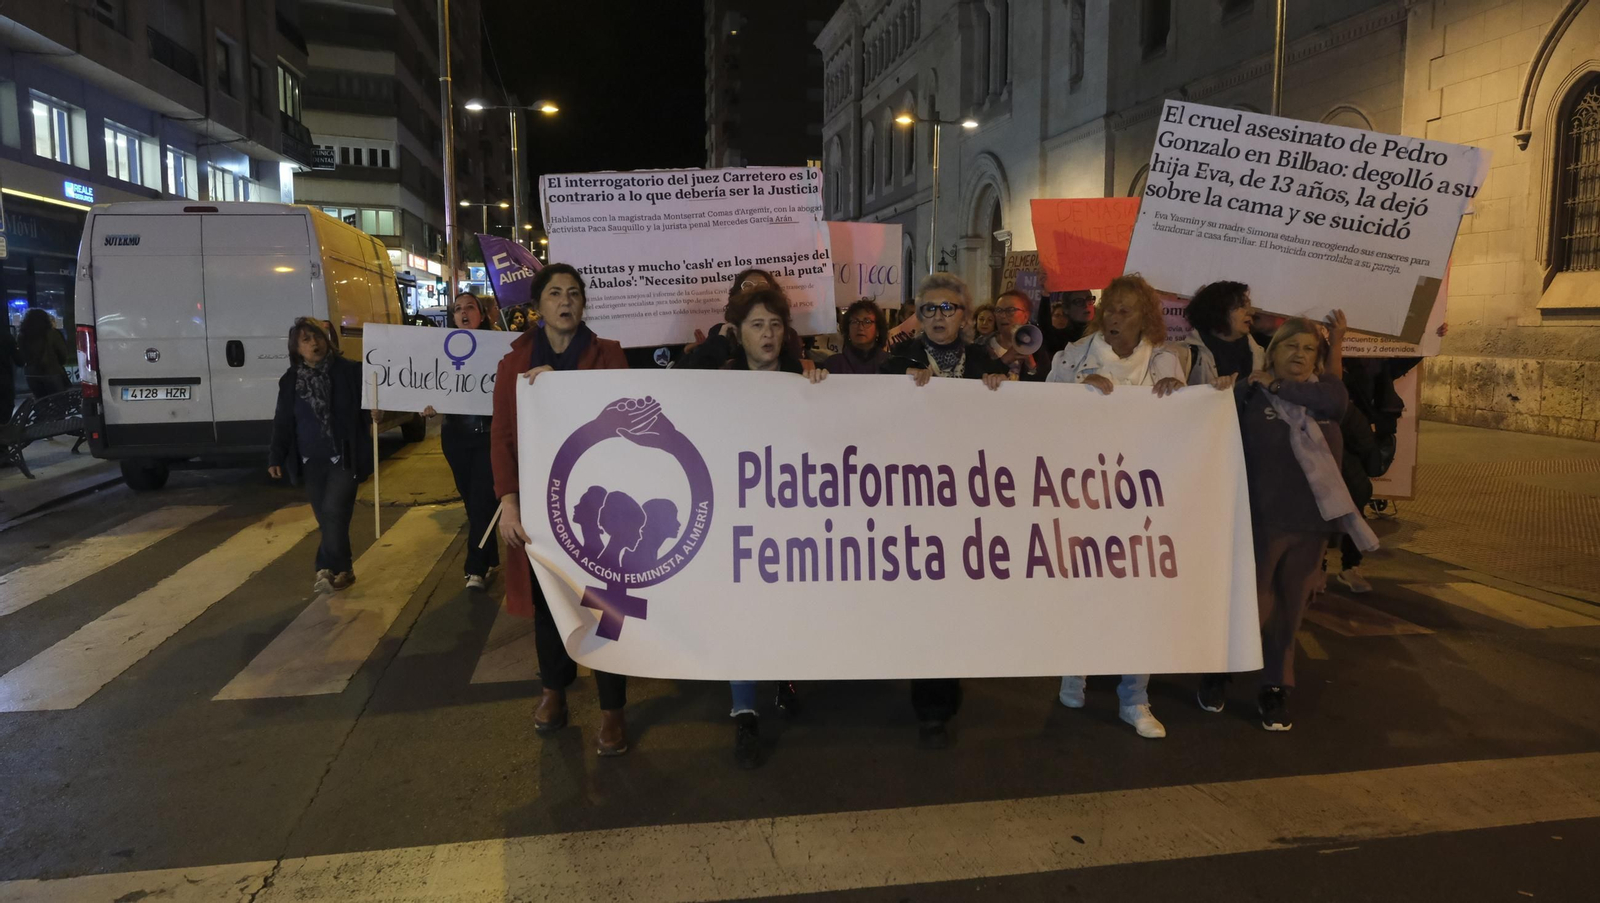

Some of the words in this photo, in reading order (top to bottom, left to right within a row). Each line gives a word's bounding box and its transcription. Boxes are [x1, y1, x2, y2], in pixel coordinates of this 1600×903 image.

[1163, 105, 1185, 124] El
[1188, 114, 1242, 134] cruel
[1245, 123, 1345, 150] asesinato
[1350, 133, 1377, 155] de
[1381, 139, 1448, 166] Pedro
[547, 177, 561, 189] El
[565, 175, 664, 190] interrogatorio
[667, 174, 689, 186] del
[691, 173, 720, 187] juez
[723, 171, 786, 182] Carretero
[789, 172, 803, 180] es
[806, 169, 818, 180] lo
[1158, 130, 1240, 159] Gonzalo
[1245, 149, 1271, 165] en
[1276, 149, 1348, 177] Bilbao:
[1352, 161, 1433, 191] degolló
[1437, 181, 1449, 194] a
[1452, 183, 1478, 198] su
[73, 182, 94, 196] REALE
[549, 191, 615, 203] contrario
[618, 192, 626, 201] a
[629, 190, 642, 201] lo
[646, 191, 672, 206] que
[675, 184, 726, 200] debería
[729, 186, 750, 197] ser
[752, 185, 765, 196] la
[767, 183, 819, 195] Justicia
[1151, 153, 1189, 180] hija
[1194, 162, 1234, 187] Eva,
[1239, 169, 1266, 189] de
[1269, 174, 1294, 193] 13
[1296, 180, 1349, 207] años,
[1355, 187, 1375, 208] la
[1380, 192, 1429, 220] dejó
[551, 216, 591, 224] Hablamos
[609, 214, 616, 222] la
[617, 214, 662, 223] magistrada
[663, 211, 706, 221] Montserrat
[707, 209, 733, 218] Comas
[552, 226, 586, 234] activista
[588, 224, 606, 232] Paca
[607, 223, 645, 233] Sauquillo
[646, 224, 652, 232] y
[653, 223, 661, 231] la
[662, 223, 688, 232] jurista
[689, 221, 711, 230] penal
[712, 218, 748, 227] Mercedes
[749, 216, 774, 224] García
[775, 215, 793, 223] Arán
[1145, 181, 1201, 204] sobre
[1204, 187, 1222, 207] la
[1227, 196, 1284, 218] cama
[1285, 207, 1300, 226] y
[1303, 210, 1326, 226] se
[1329, 215, 1411, 240] suicidó
[1154, 211, 1168, 219] Eva
[1199, 219, 1207, 228] y
[1218, 222, 1245, 233] madre
[1246, 226, 1278, 240] Simona
[1280, 233, 1311, 246] estaban
[1311, 241, 1359, 254] recogiendo
[1360, 248, 1374, 256] sus
[1376, 250, 1408, 263] enseres
[1409, 257, 1430, 267] para
[1203, 232, 1221, 241] casa
[1259, 240, 1268, 249] El
[1307, 251, 1354, 266] controlaba
[1361, 261, 1371, 269] su
[628, 265, 635, 276] y
[638, 260, 681, 272] mucho
[683, 259, 714, 271] 'cash'
[716, 260, 732, 268] en
[735, 256, 752, 267] los
[755, 252, 810, 266] mensajes
[812, 249, 830, 260] del
[639, 274, 698, 286] "Necesito
[784, 266, 795, 277] la
[797, 263, 827, 278] puta"
[131, 388, 158, 399] 4128
[165, 387, 187, 399] HZR
[365, 348, 396, 388] Si
[400, 357, 453, 397] duele,
[456, 374, 477, 393] no
[738, 444, 958, 509] Plataforma
[968, 449, 1016, 508] de
[1032, 452, 1165, 510] Acción
[550, 478, 580, 559] PLATAFORMA
[580, 556, 622, 583] ACCIÓN
[624, 555, 684, 584] FEMINISTA
[682, 500, 709, 555] ALMERÍA
[732, 517, 946, 584] Feminista
[962, 517, 1011, 581] de
[1025, 515, 1178, 580] Almería
